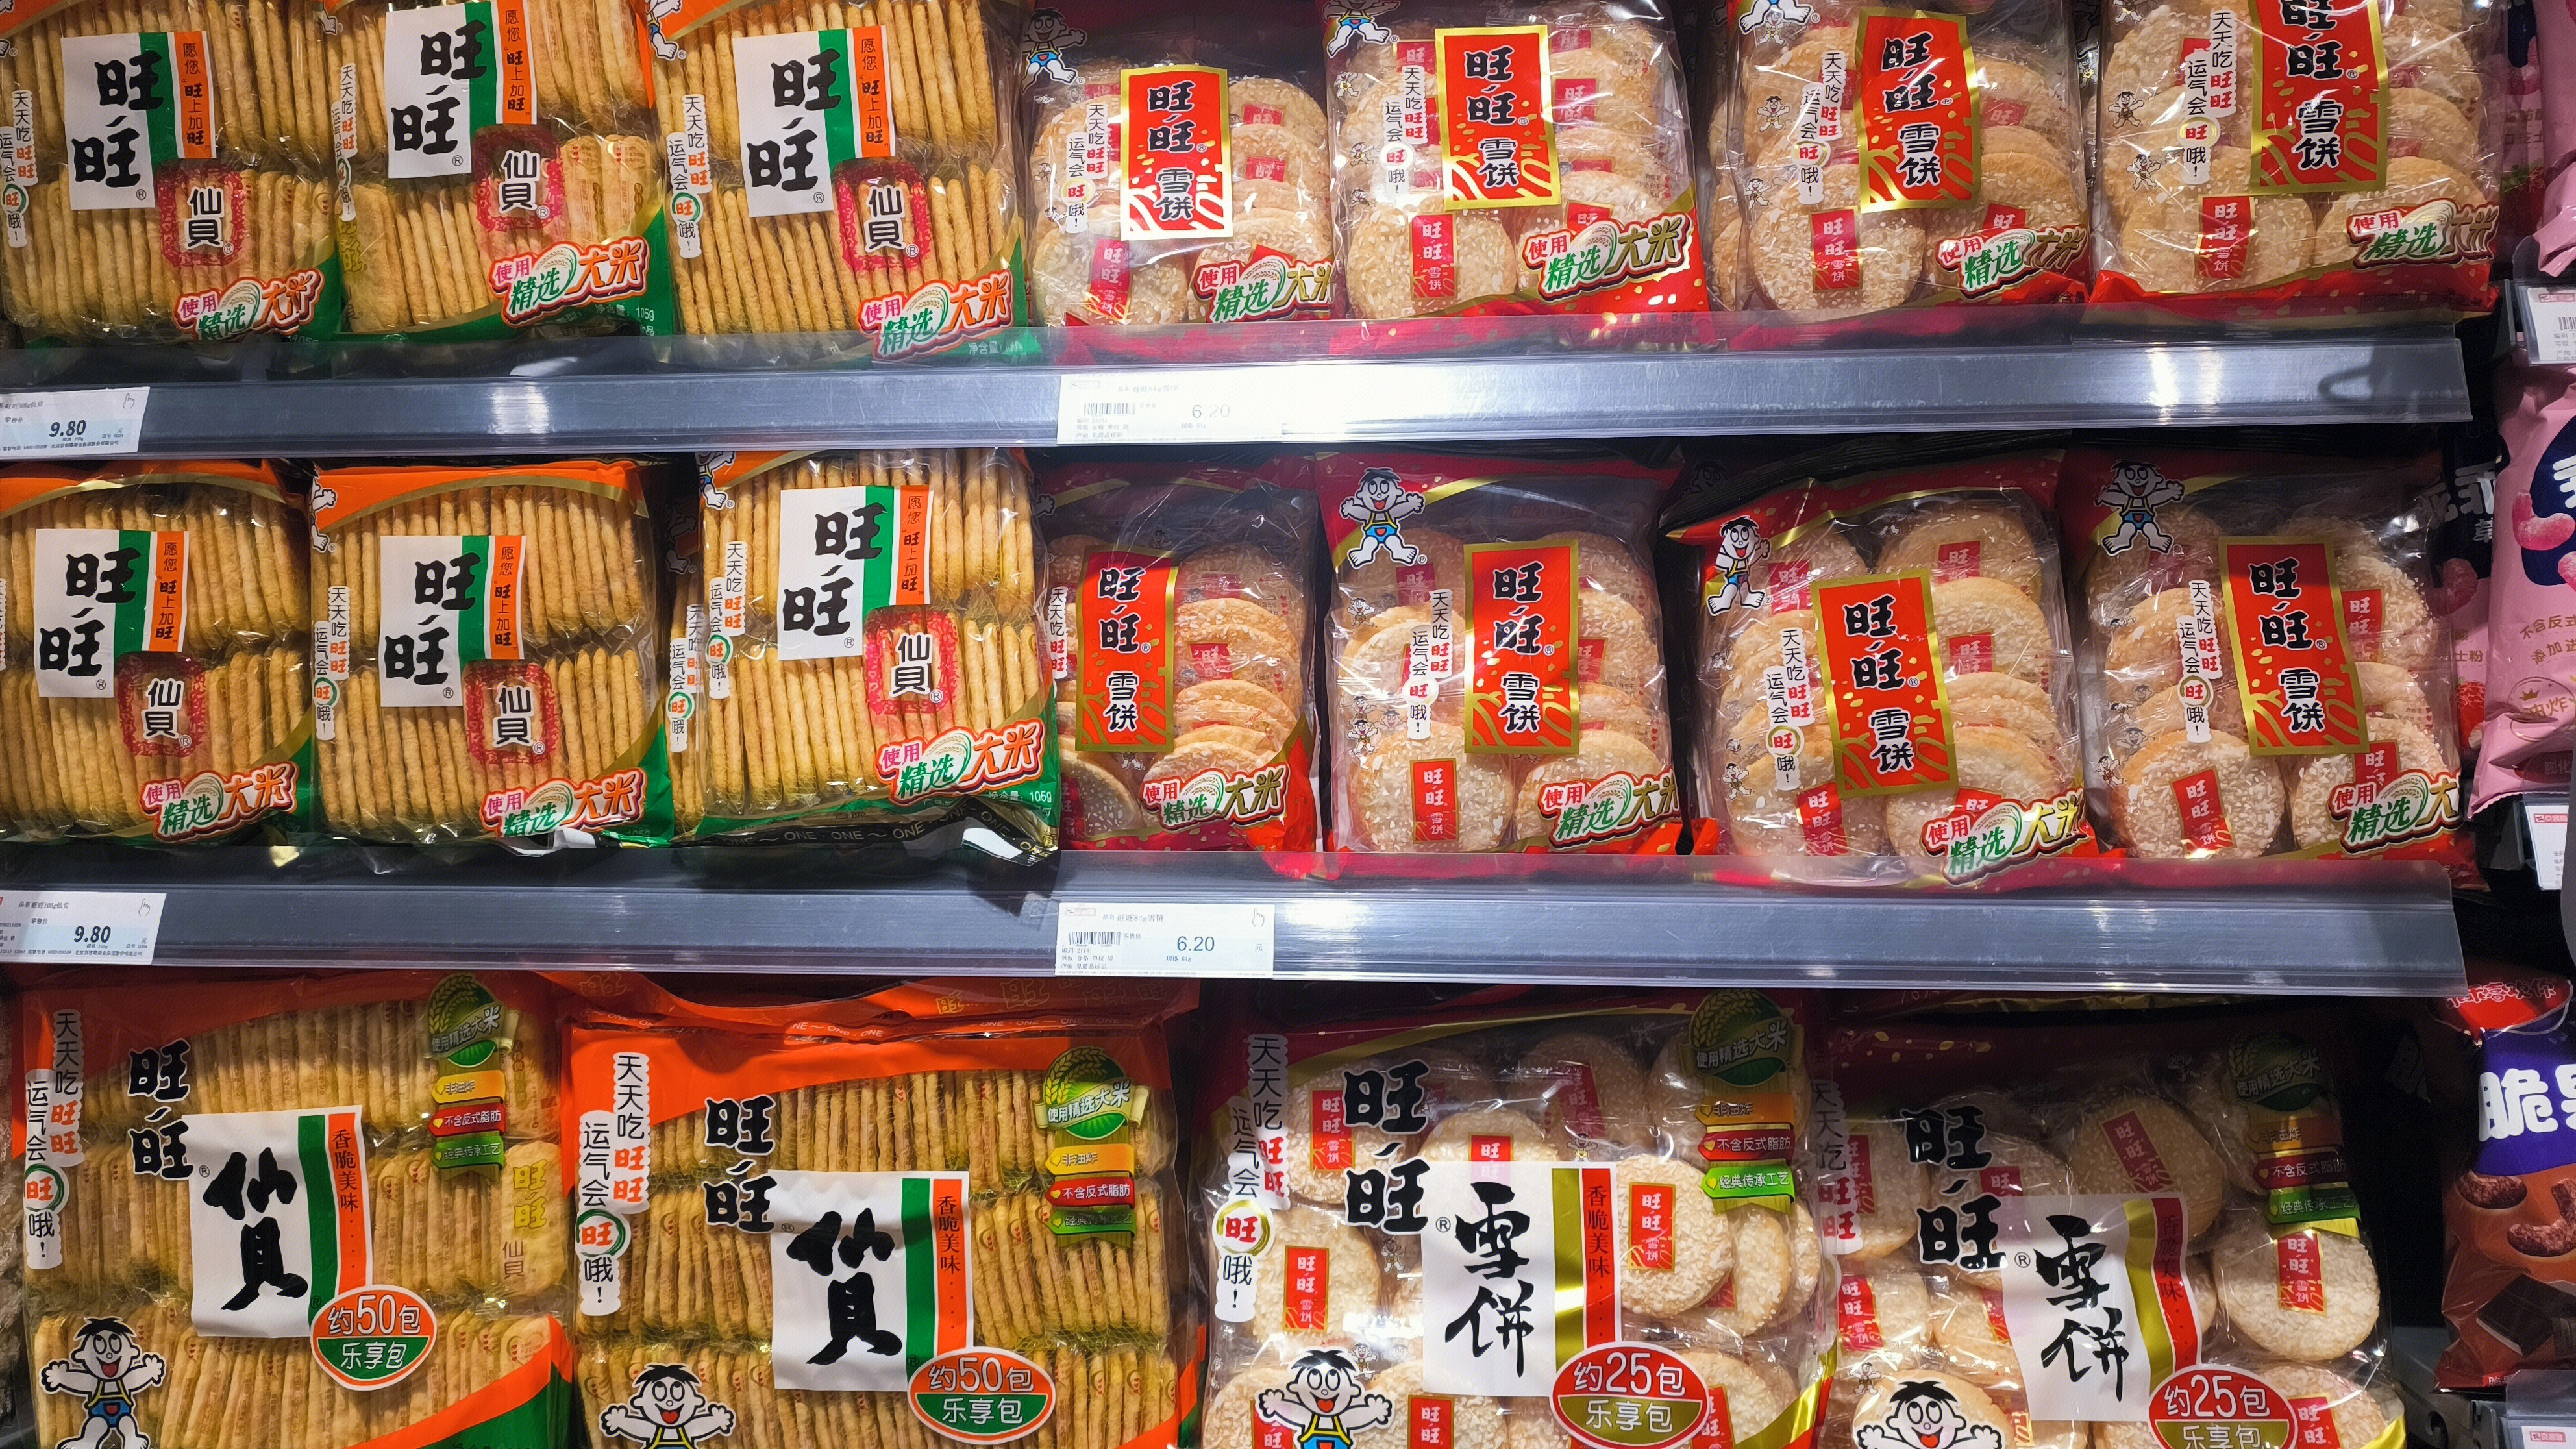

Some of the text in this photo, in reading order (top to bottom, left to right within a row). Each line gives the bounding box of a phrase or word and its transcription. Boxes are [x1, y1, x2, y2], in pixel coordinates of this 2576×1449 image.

[391, 20, 486, 155] 旺旺
[1464, 45, 1515, 126] 旺旺
[1881, 32, 1938, 113] 旺旺
[2210, 12, 2234, 108] 天天吃旺旺
[71, 51, 164, 188] 旺旺
[747, 49, 842, 191] 旺旺
[1403, 67, 1426, 140] 天天吃旺旺
[1820, 53, 1842, 136] 天天吃旺旺
[13, 91, 36, 179] 天天吃旺旺
[684, 97, 709, 187] 天天吃旺旺
[1087, 104, 1106, 174] 天天吃旺旺
[1478, 138, 1518, 188] 雪饼
[1899, 123, 1940, 188] 雪饼
[2294, 102, 2342, 170] 雪饼
[502, 153, 538, 211] 仙貝
[1156, 168, 1194, 221] 雪饼
[188, 188, 223, 247] 仙貝
[868, 188, 903, 249] 仙貝
[2365, 226, 2436, 259] 精选
[496, 243, 641, 314] 使用 精选 大米
[1528, 219, 1683, 290] 使用 精选 大米
[1964, 240, 2021, 288] 精选
[180, 273, 319, 321] 使用 大米
[863, 274, 1009, 356] 使用 精选 大米
[1199, 267, 1268, 319] 使用 精选
[49, 420, 86, 437] 9.80
[1192, 404, 1230, 419] 6.20
[724, 543, 743, 629] 天天吃旺旺
[783, 502, 887, 636] 旺旺
[40, 547, 141, 676] 旺旺
[330, 588, 349, 673] 天天吃旺旺
[384, 552, 480, 686] 旺旺
[1098, 567, 1145, 654] 旺旺
[1430, 591, 1450, 673] 天天吃旺旺
[1493, 562, 1545, 656] 旺旺
[2190, 581, 2220, 672] 天天吃旺旺
[2249, 557, 2314, 650] 旺旺
[894, 635, 930, 695] 仙貝
[1782, 630, 1811, 719] 天天吃旺旺
[1844, 594, 1906, 690] 旺旺
[145, 680, 181, 736] 仙貝
[497, 688, 532, 744] 仙貝
[1103, 671, 1139, 733] 雪饼
[1499, 672, 1540, 734] 雪饼
[2279, 668, 2325, 734] 雪饼
[880, 725, 1036, 799] 使用 精选 大米
[1869, 708, 1915, 774] 雪饼
[146, 765, 288, 834] 使用 精选 大米
[487, 773, 642, 825] 使用 大米
[1145, 765, 1287, 816] 使用 大米
[1543, 785, 1616, 839] 使用 精选
[2334, 784, 2375, 811] 使用
[2348, 797, 2411, 843] 精选
[784, 832, 817, 841] ONE
[831, 831, 864, 840] ONE
[893, 822, 925, 839] ONE
[1927, 819, 1968, 843] 使用
[1948, 826, 2007, 874] 精选
[74, 926, 111, 943] 9.80
[1177, 936, 1215, 952] 6.20
[51, 1012, 79, 1155] 天天吃旺旺
[128, 1040, 194, 1180] 旺旺
[445, 1111, 501, 1128] 不含反式脂肪
[615, 1054, 647, 1204] 天天吃旺旺
[1252, 1038, 1288, 1199] 天天吃旺旺
[1343, 1059, 1430, 1235] 旺旺
[1716, 1137, 1791, 1152] 不含反式脂肪
[705, 1095, 776, 1235] 旺旺
[1063, 1183, 1130, 1199] 不含反式脂肪
[1720, 1171, 1790, 1189] 经典传承工艺
[1901, 1106, 2009, 1270] 旺旺
[1445, 1182, 1535, 1377] 雪饼
[328, 1295, 421, 1335] 约50包
[340, 1341, 407, 1370] 乐享包
[928, 1358, 1035, 1393] 约50包
[1573, 1354, 1685, 1396] 约25包
[943, 1398, 1023, 1426] 乐享包
[1585, 1400, 1673, 1432] 乐享包
[2164, 1374, 2270, 1417] 约25包
